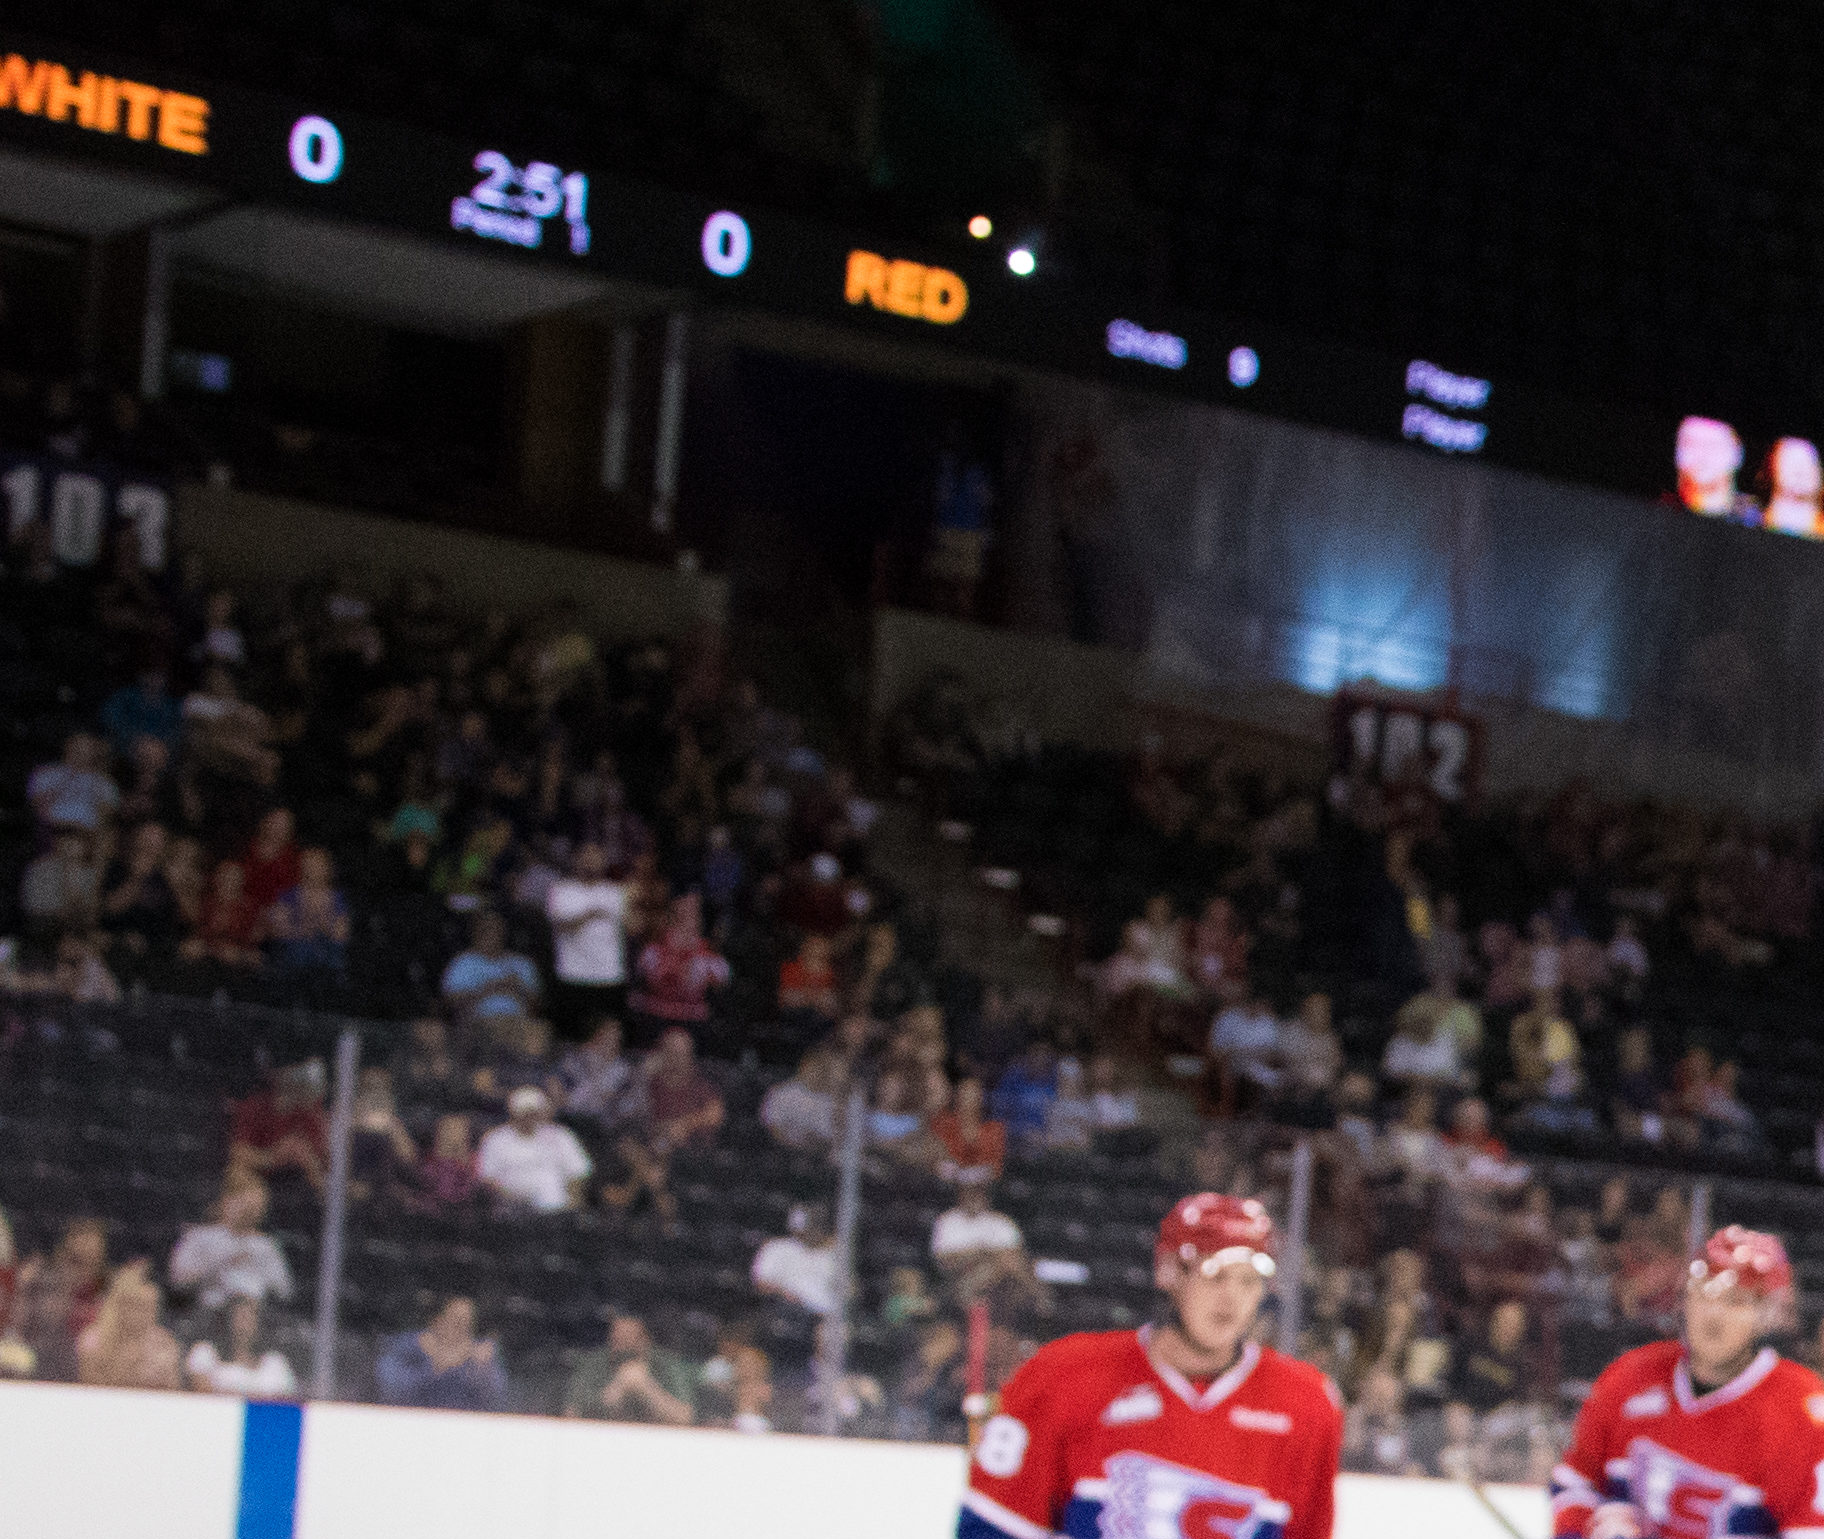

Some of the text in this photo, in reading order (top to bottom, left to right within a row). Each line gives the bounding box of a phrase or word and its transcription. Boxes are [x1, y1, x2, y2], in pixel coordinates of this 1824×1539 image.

[0, 53, 211, 155] WHITE
[289, 116, 343, 183] 0
[701, 210, 751, 277] 0
[844, 249, 970, 325] RED
